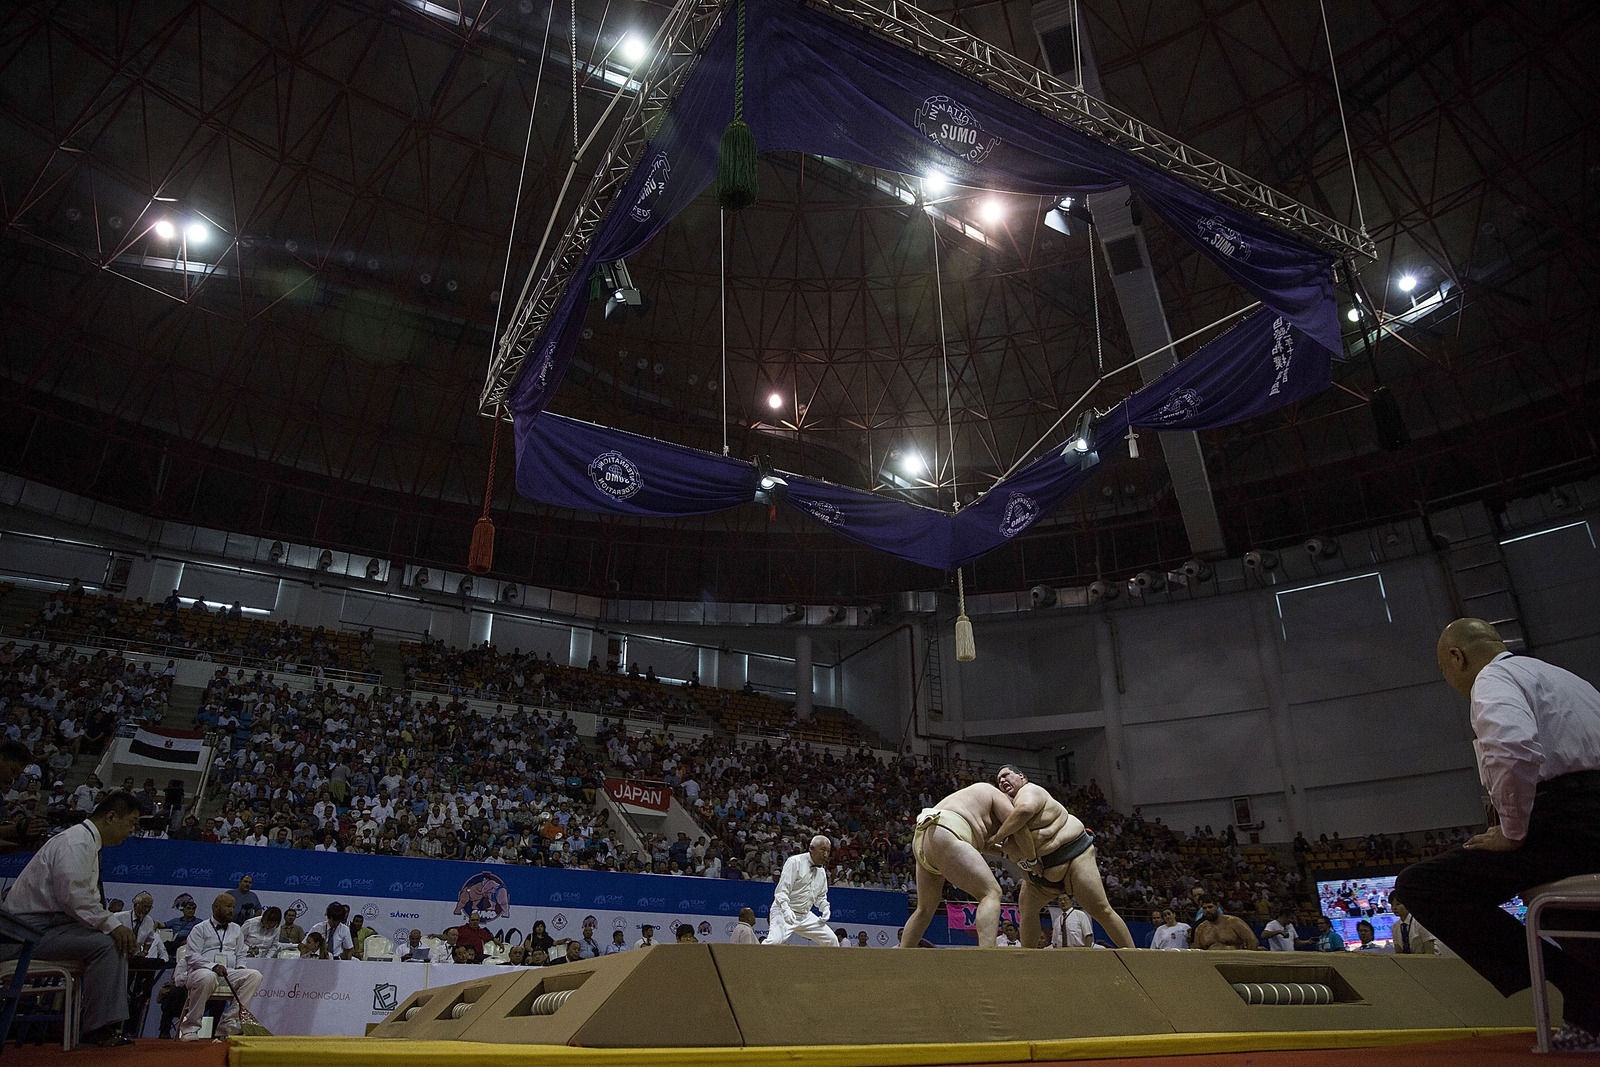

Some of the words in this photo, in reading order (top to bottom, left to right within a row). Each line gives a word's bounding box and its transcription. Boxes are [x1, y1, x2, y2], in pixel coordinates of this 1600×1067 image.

[940, 123, 977, 145] SUMO
[1210, 233, 1235, 256] SUMO
[613, 783, 662, 805] JAPAN
[390, 910, 420, 919] SANKYO
[254, 989, 285, 998] SOUND
[301, 991, 351, 1001] MONGOLIA
